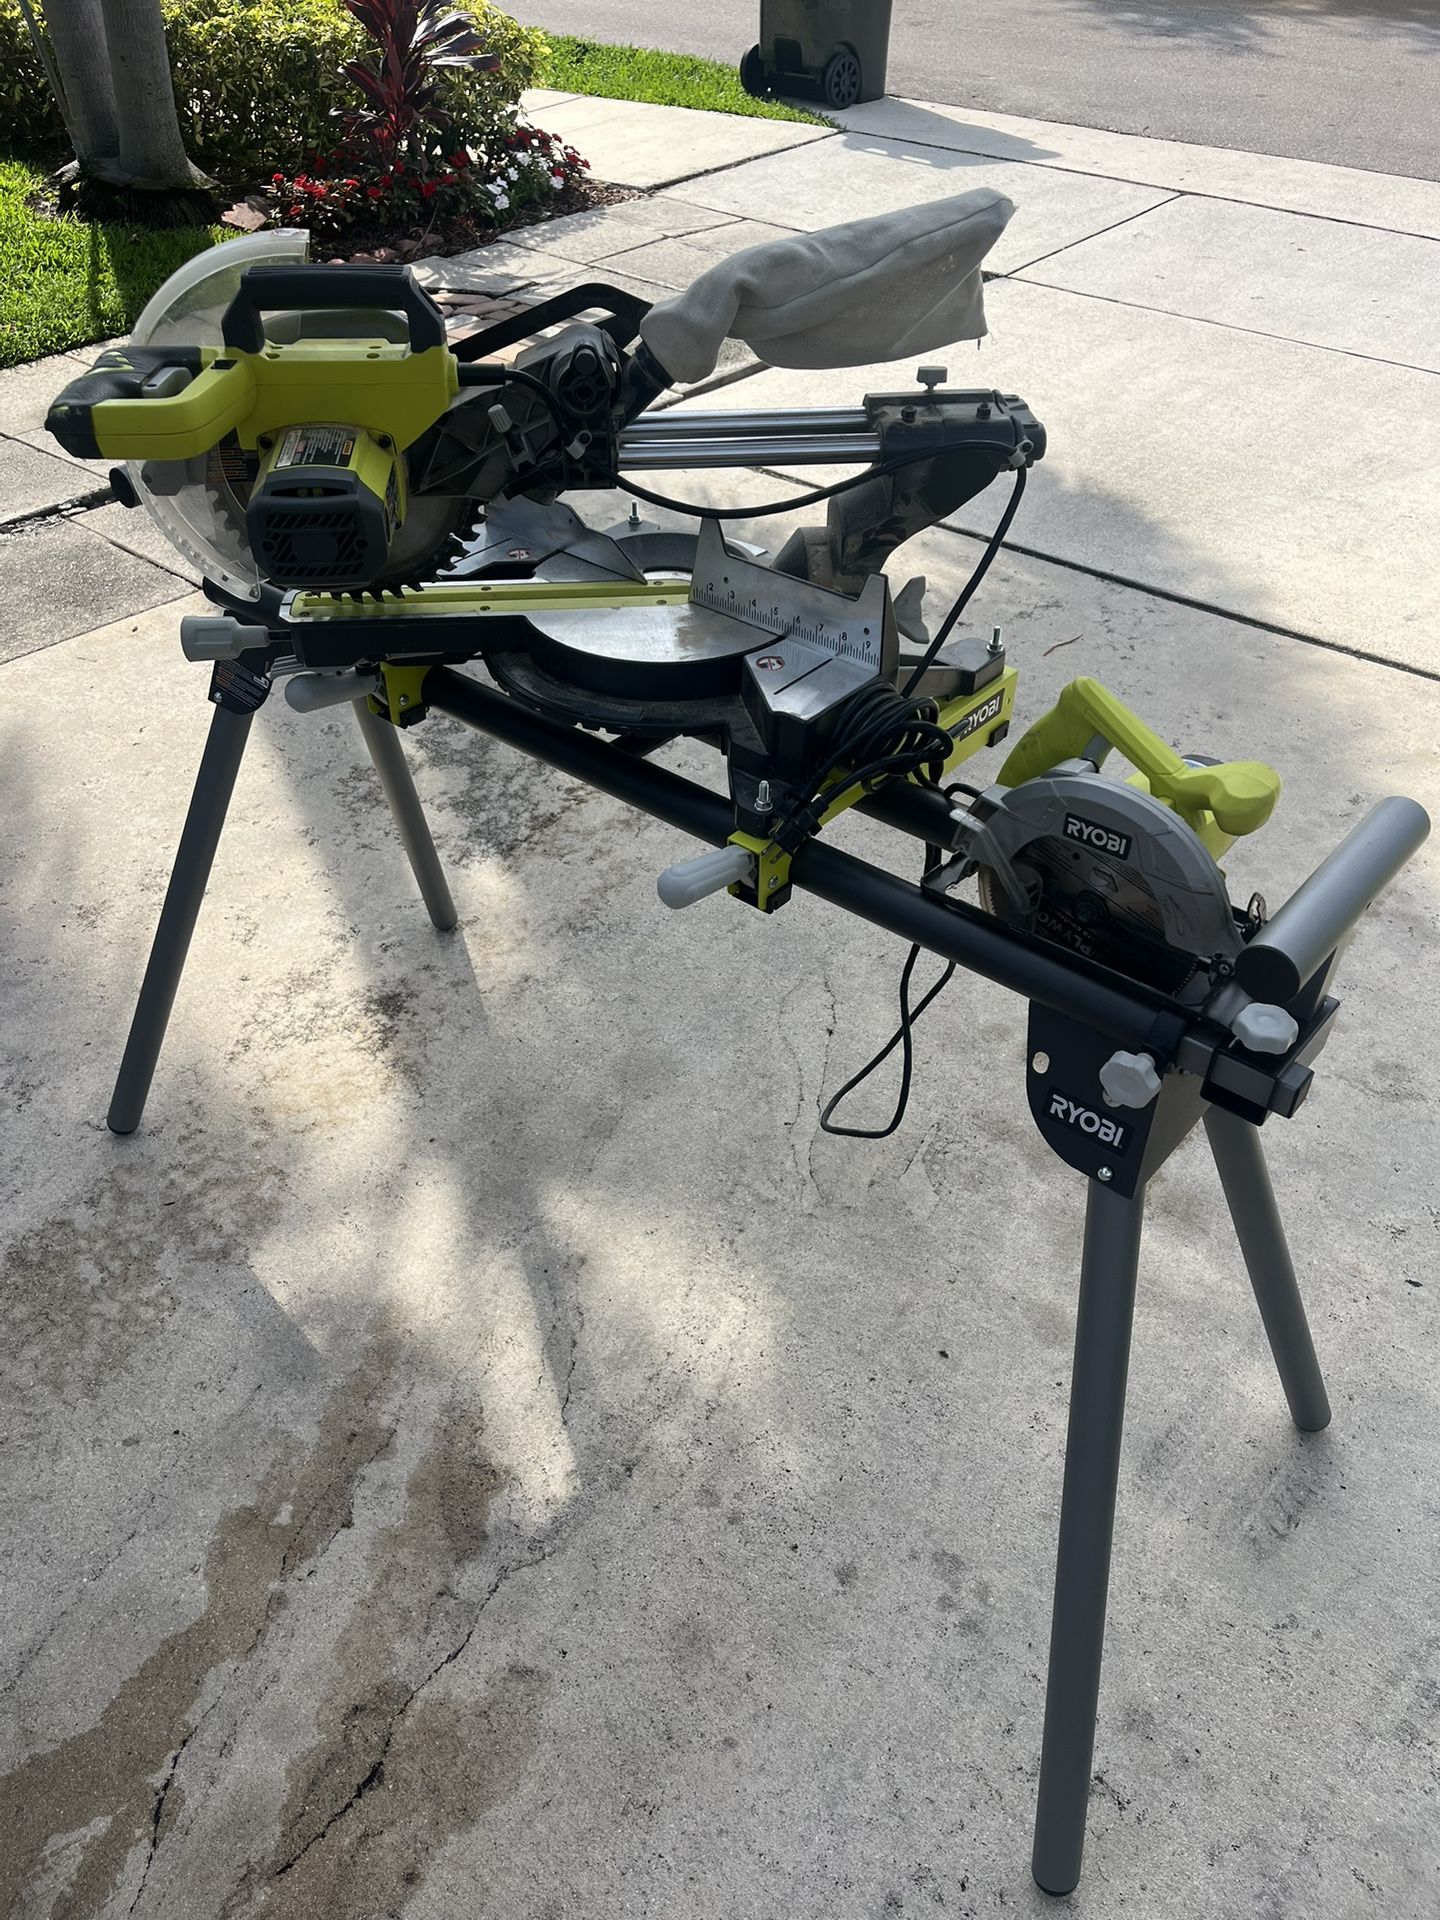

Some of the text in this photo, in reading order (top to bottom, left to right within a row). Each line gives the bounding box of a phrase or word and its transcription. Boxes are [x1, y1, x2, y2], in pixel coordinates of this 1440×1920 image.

[709, 583, 872, 650] 2 3 4 5 6 7 8 9
[1067, 817, 1127, 855] RYOBI
[1049, 1093, 1124, 1147] RYOBI
